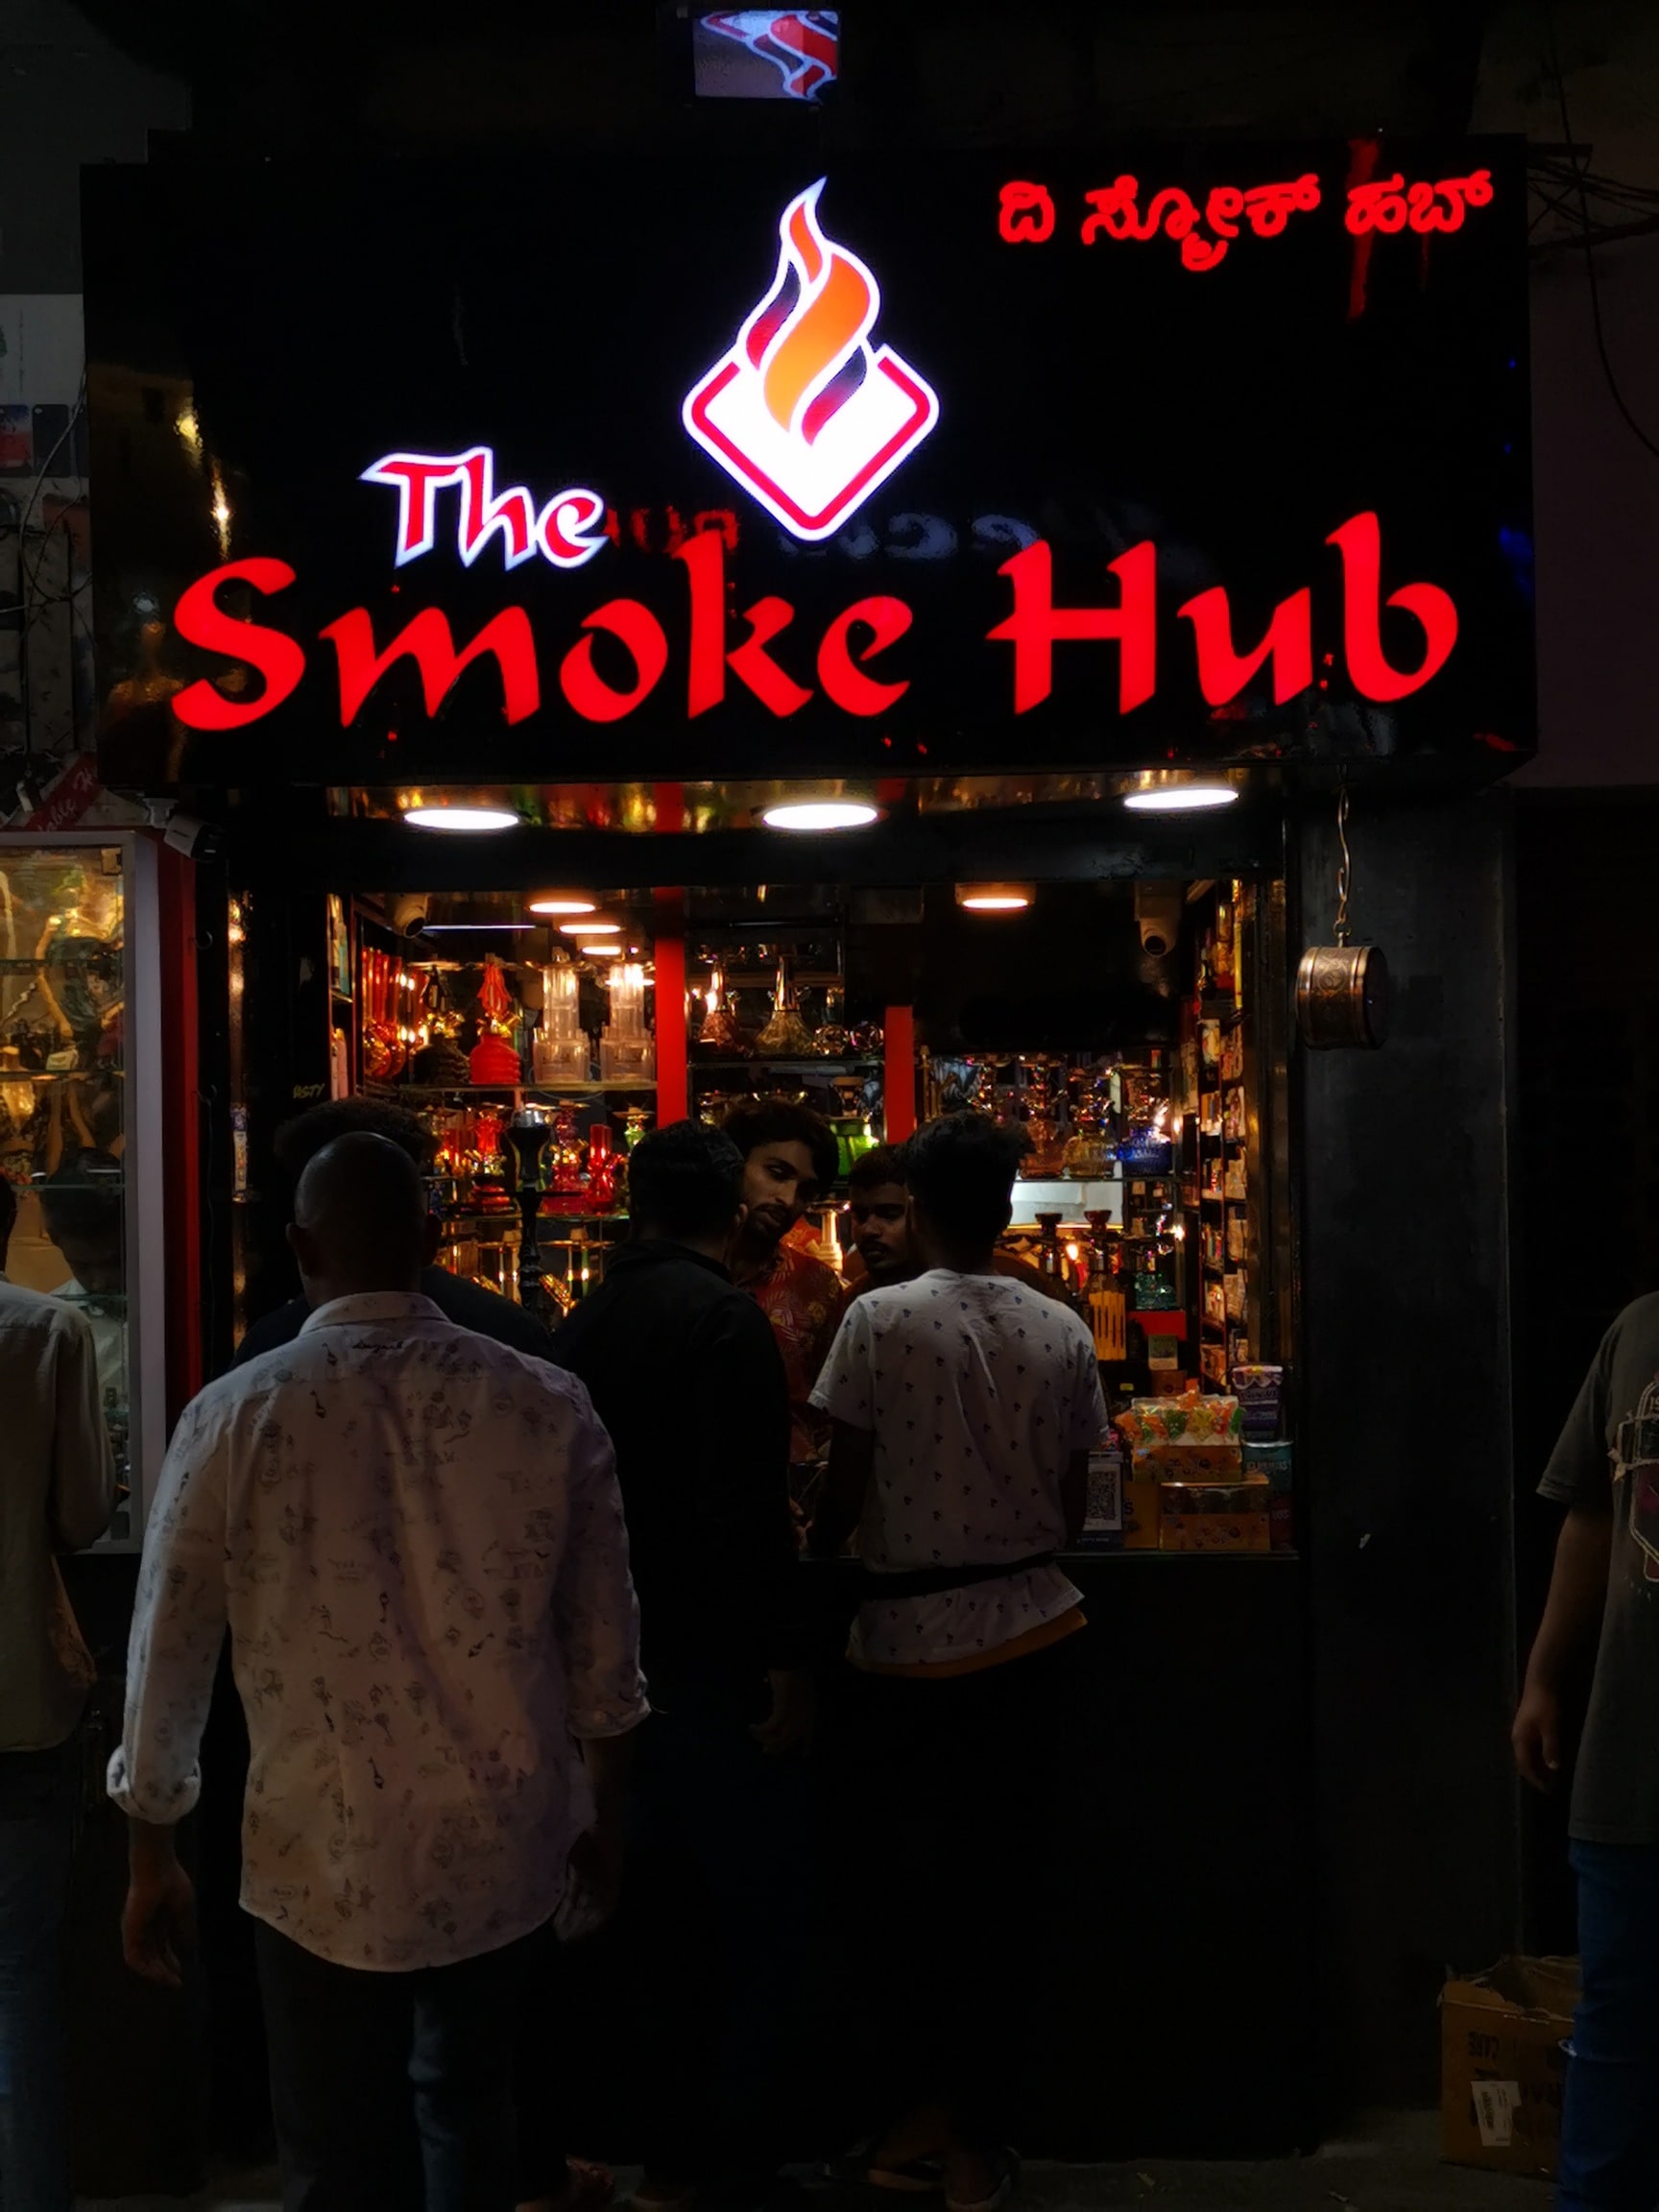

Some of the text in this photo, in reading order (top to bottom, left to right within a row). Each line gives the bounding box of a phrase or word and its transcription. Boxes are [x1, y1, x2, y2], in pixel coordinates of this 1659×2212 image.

[998, 180, 1056, 244] ದಿ
[1343, 169, 1494, 237] ಹಬ್
[361, 446, 606, 569] The
[171, 511, 1459, 732] Smoke Hub
